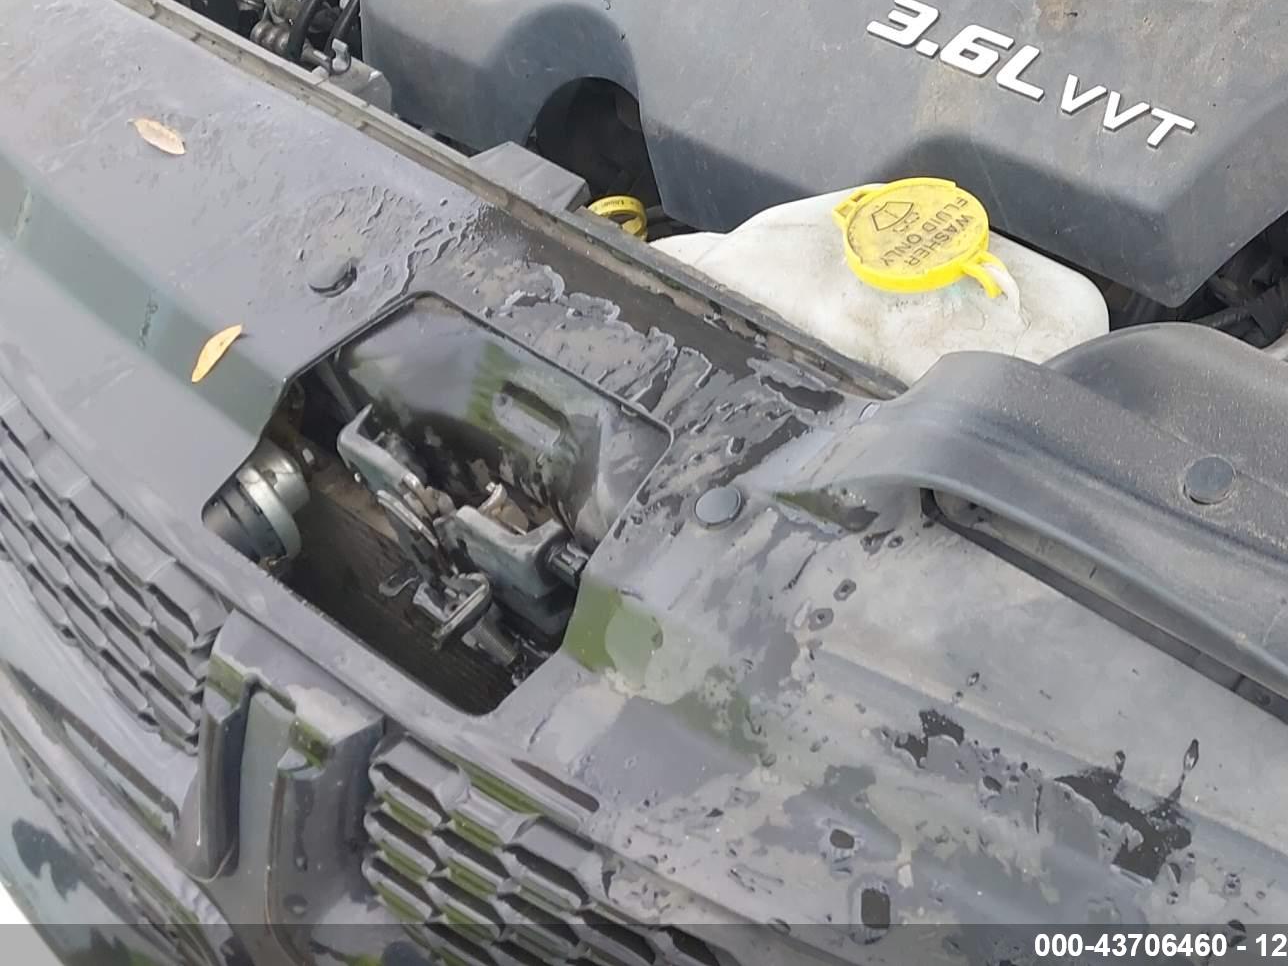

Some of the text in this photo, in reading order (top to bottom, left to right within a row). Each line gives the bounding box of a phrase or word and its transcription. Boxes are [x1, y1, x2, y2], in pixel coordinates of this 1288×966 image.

[1060, 73, 1197, 149] VVT
[881, 196, 969, 266] FLUID ONLY
[904, 213, 974, 266] WASHER
